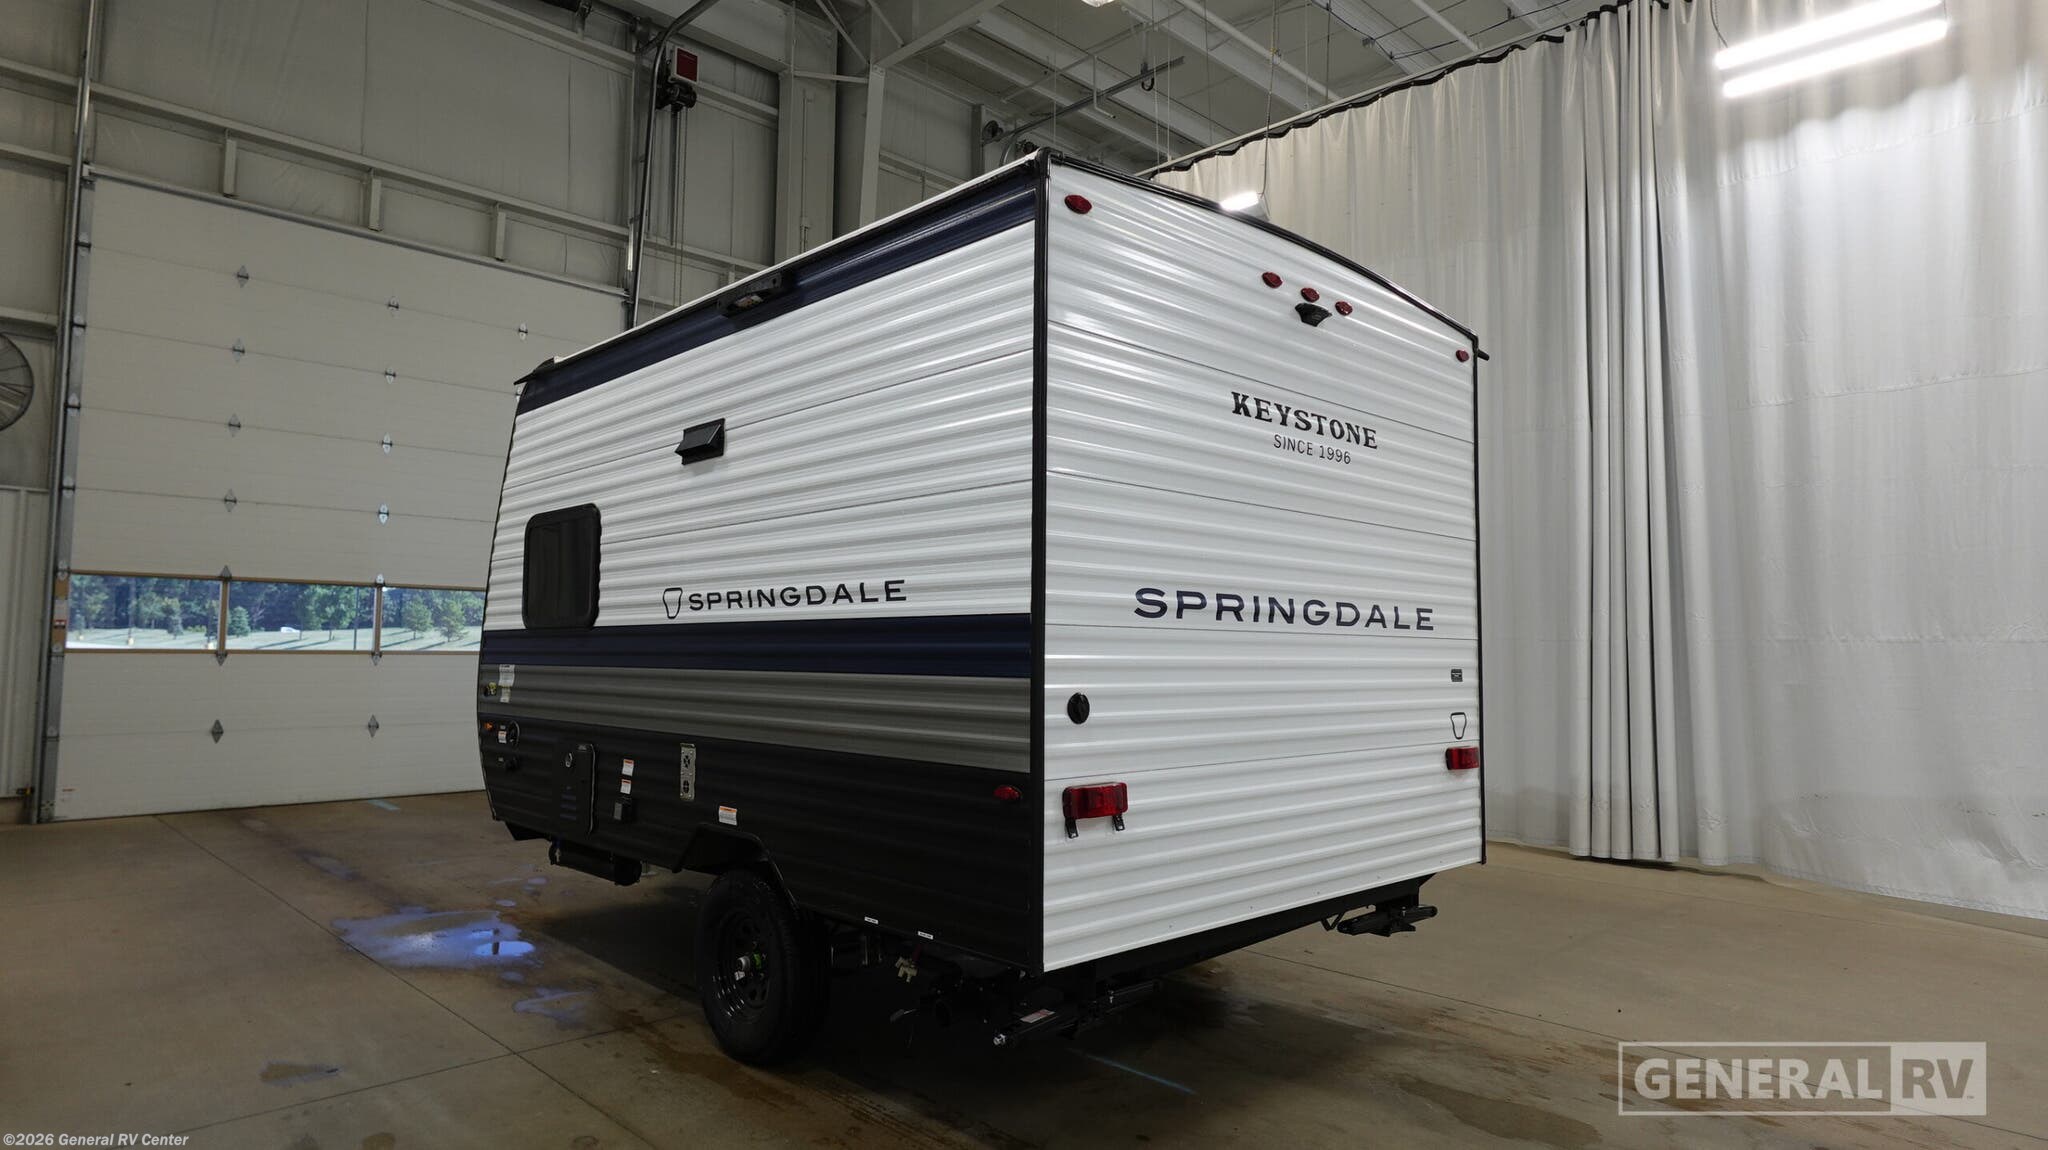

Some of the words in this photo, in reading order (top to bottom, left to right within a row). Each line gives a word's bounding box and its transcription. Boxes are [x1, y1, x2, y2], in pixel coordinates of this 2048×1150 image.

[1231, 391, 1378, 450] KEYSTONE
[1273, 434, 1313, 457] SINCE
[1319, 445, 1352, 465] 1996
[688, 579, 907, 611] SPRINGDALE
[1134, 587, 1435, 631] SPRINGDALE
